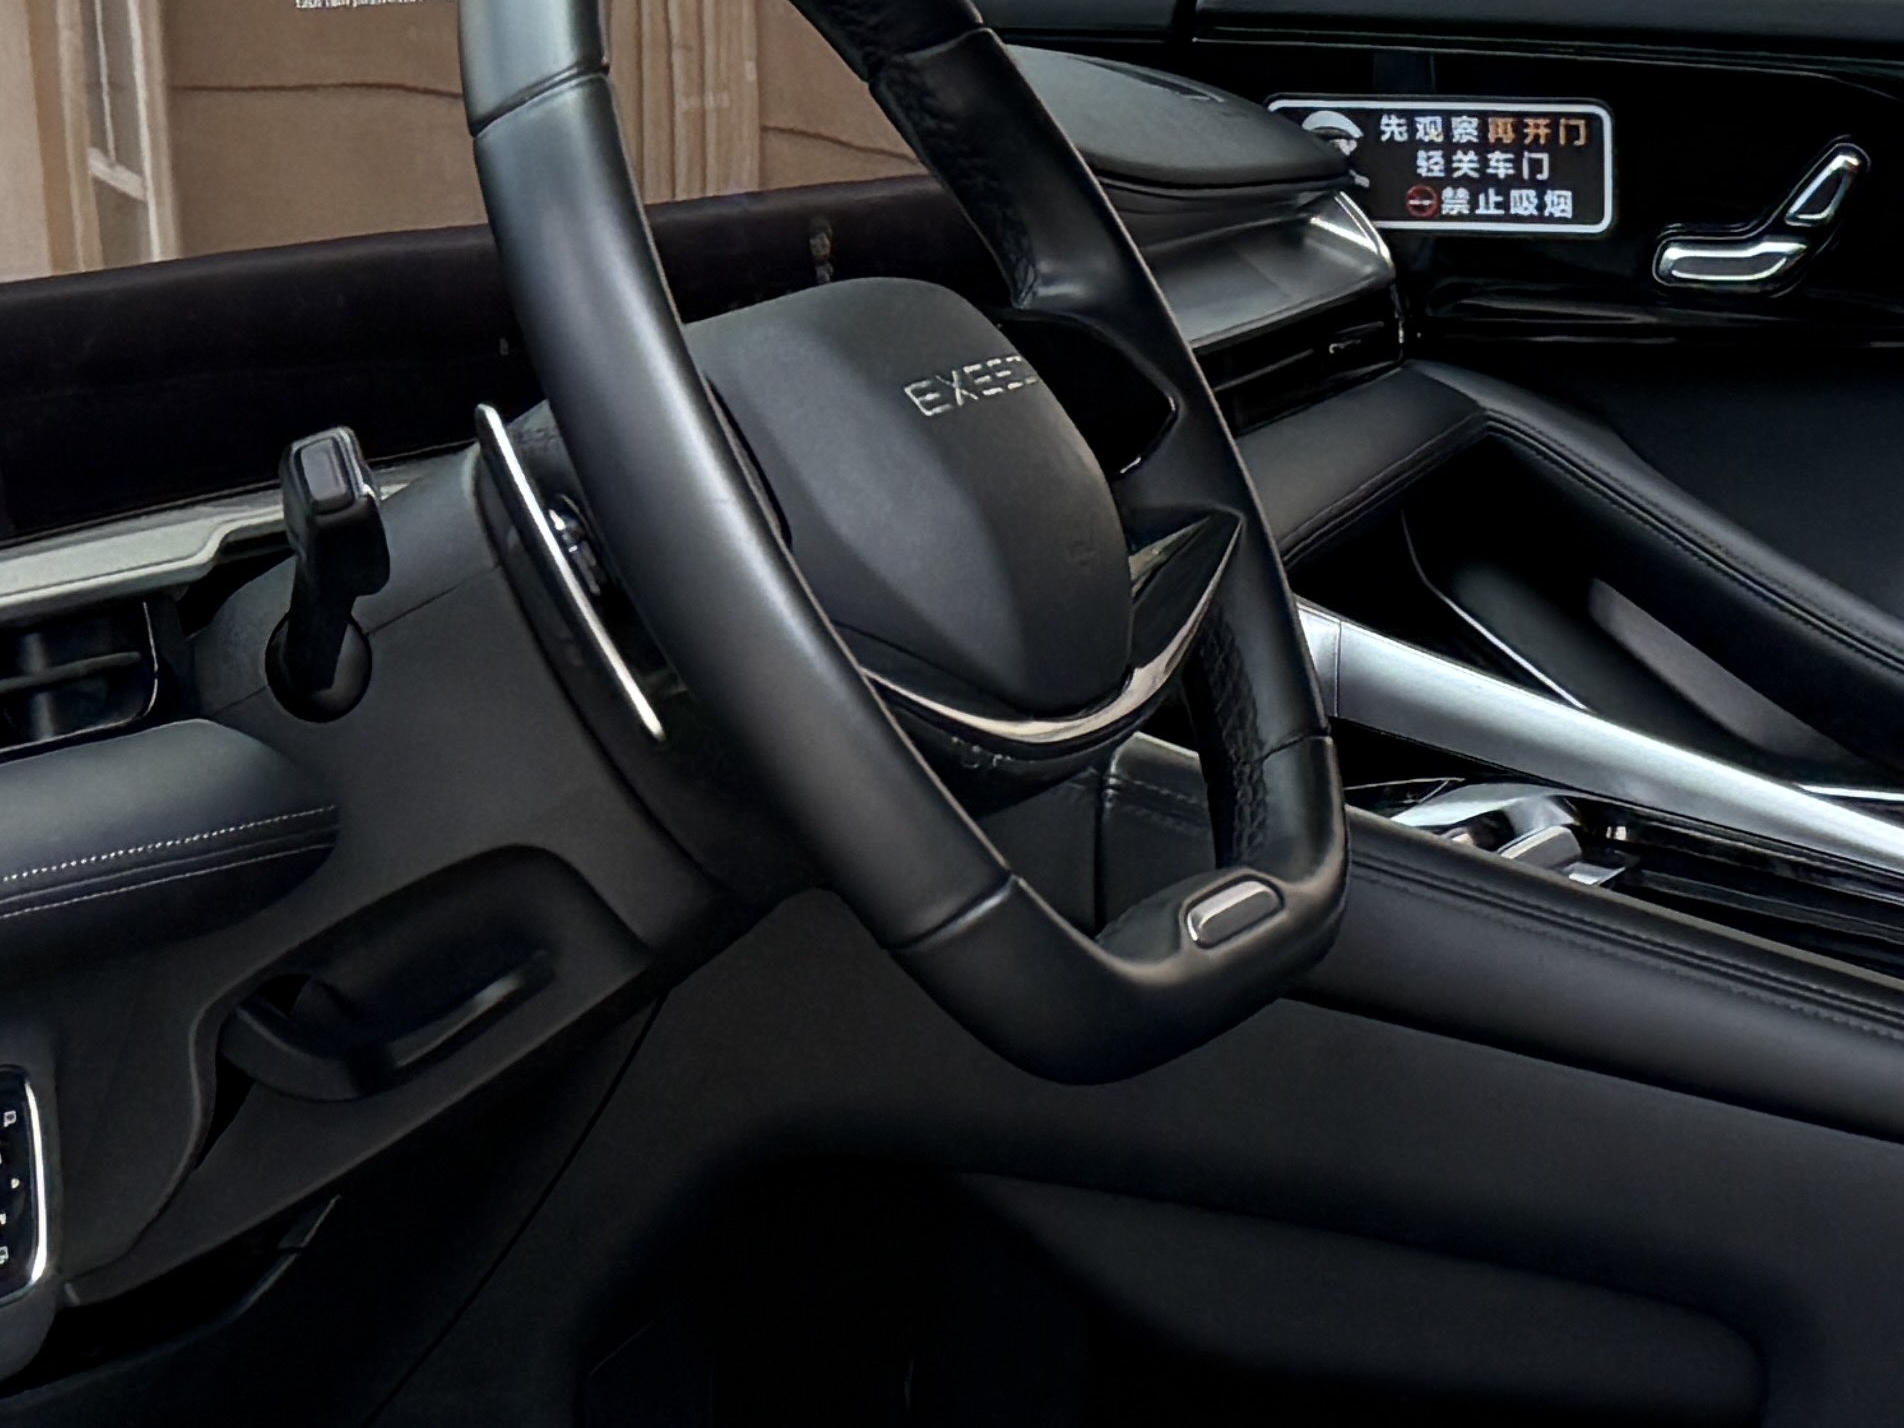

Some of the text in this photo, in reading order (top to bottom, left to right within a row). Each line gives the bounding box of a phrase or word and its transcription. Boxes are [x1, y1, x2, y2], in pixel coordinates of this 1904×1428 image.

[1380, 114, 1588, 146] 先观察再开门
[1416, 149, 1550, 181] 轻关车门
[1440, 187, 1573, 219] 禁止吸烟
